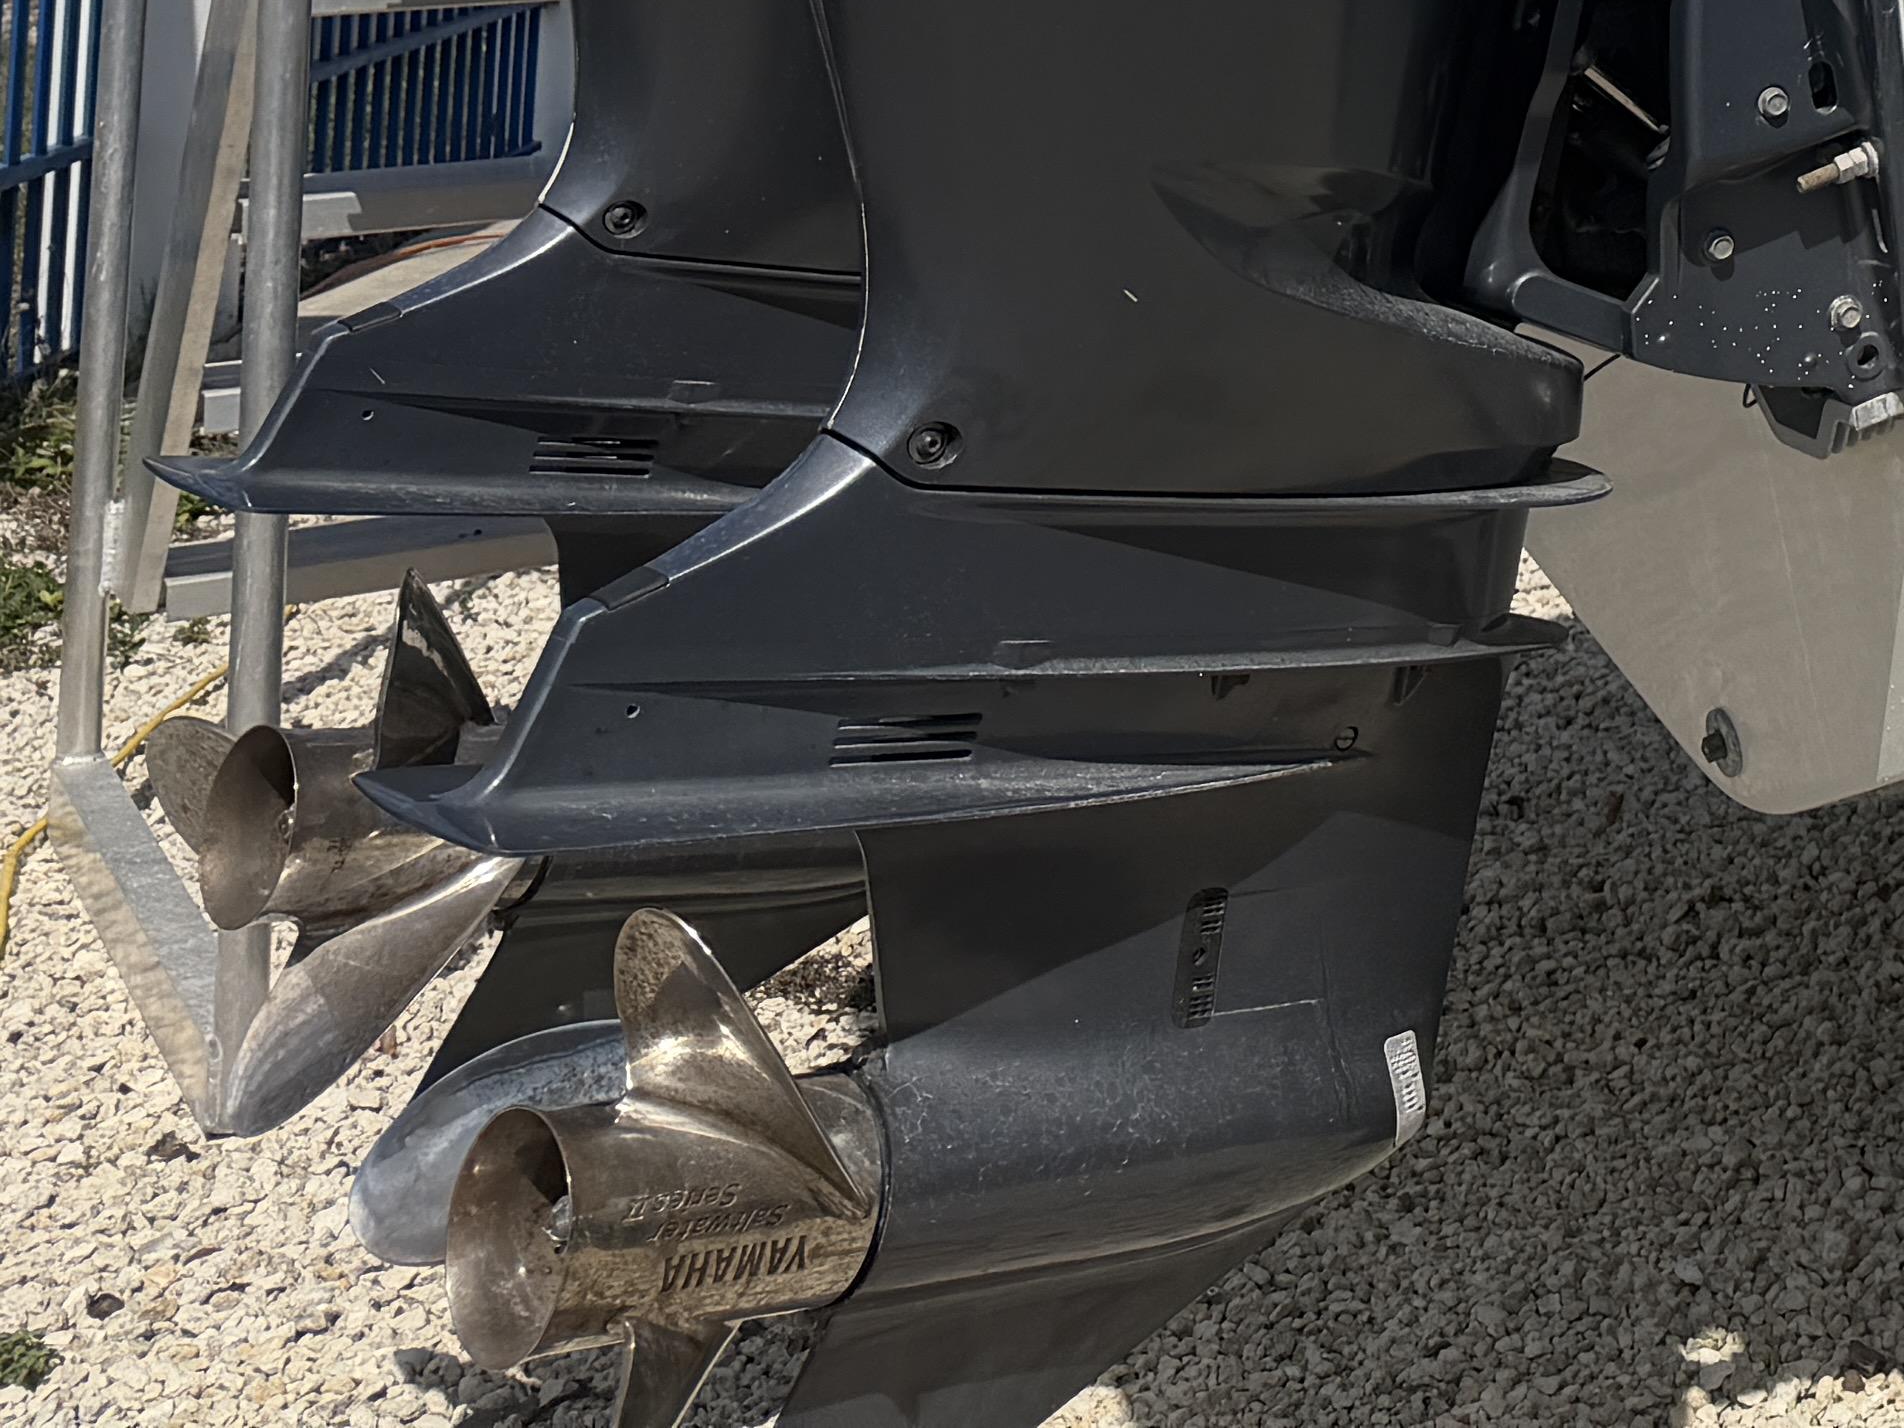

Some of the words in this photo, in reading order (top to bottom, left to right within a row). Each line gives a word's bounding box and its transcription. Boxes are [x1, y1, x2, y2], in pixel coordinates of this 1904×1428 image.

[652, 1183, 742, 1214] Series
[647, 1204, 791, 1243] Saltwater
[661, 1235, 807, 1294] YAMAHA
